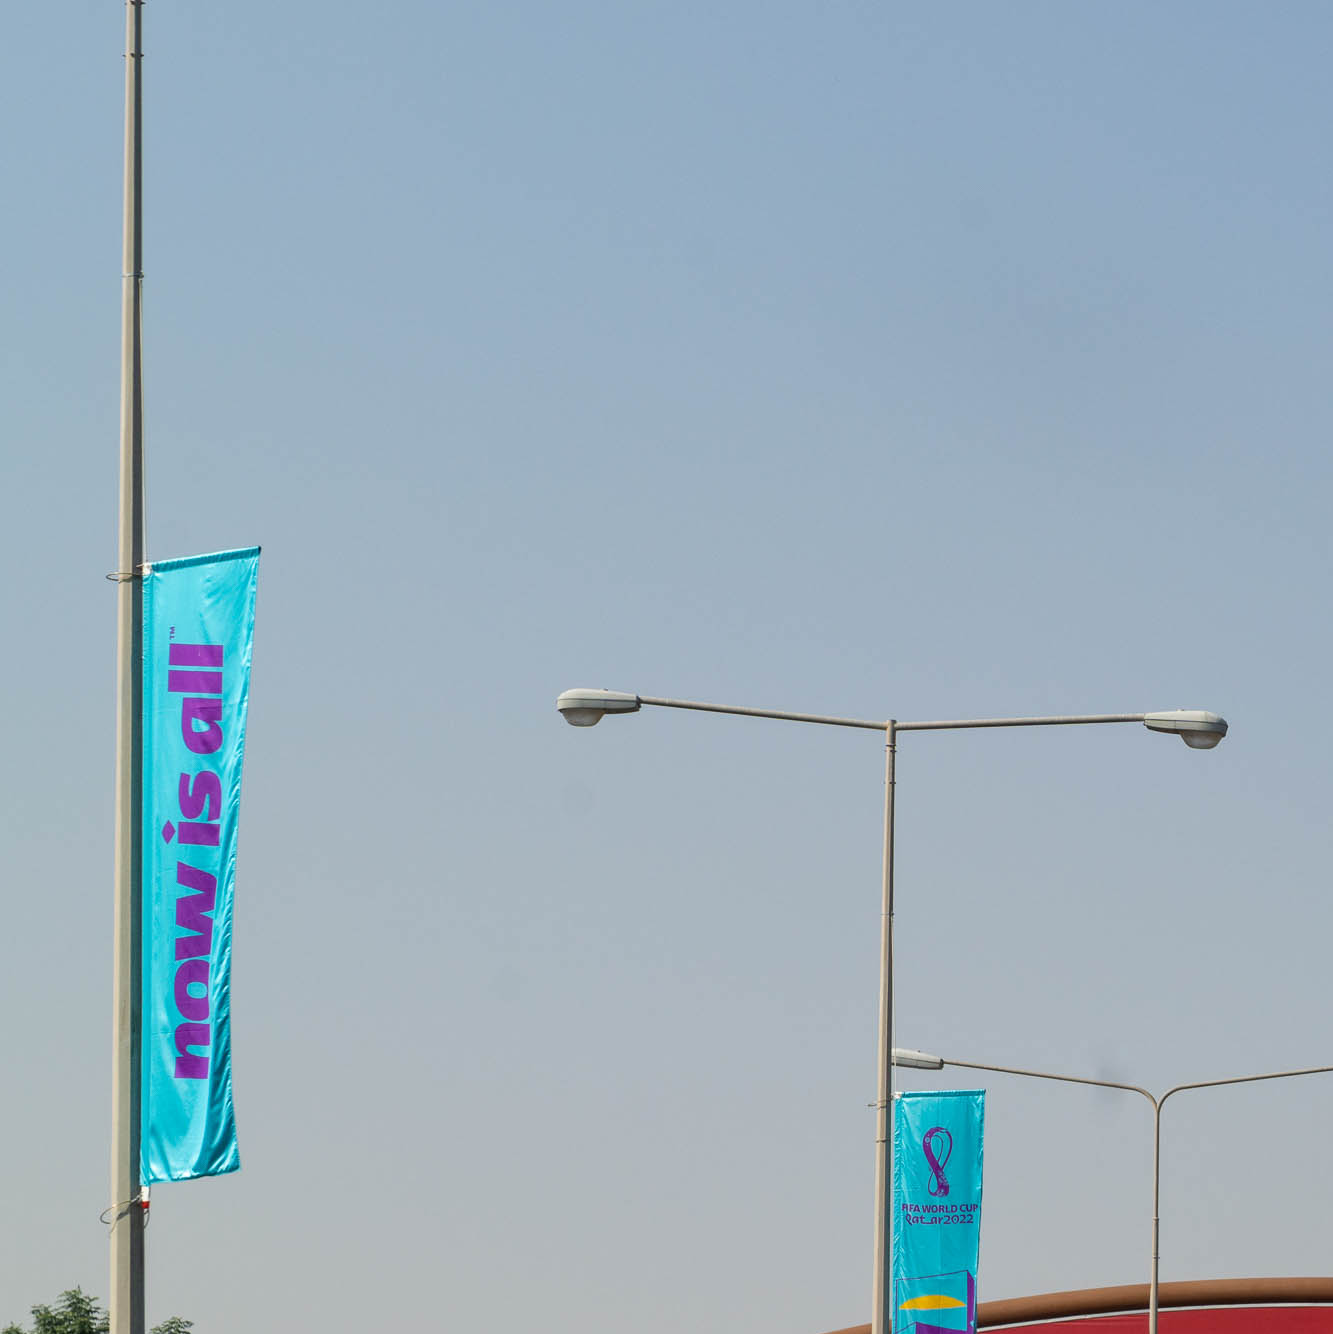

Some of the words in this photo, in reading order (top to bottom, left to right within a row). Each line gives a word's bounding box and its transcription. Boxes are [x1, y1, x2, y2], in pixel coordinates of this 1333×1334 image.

[161, 770, 222, 846] is
[174, 861, 217, 1079] now
[902, 1204, 920, 1213] FIFA
[922, 1204, 958, 1213] WORLD
[960, 1204, 978, 1212] CUP
[906, 1214, 974, 1226] Qatar2022
